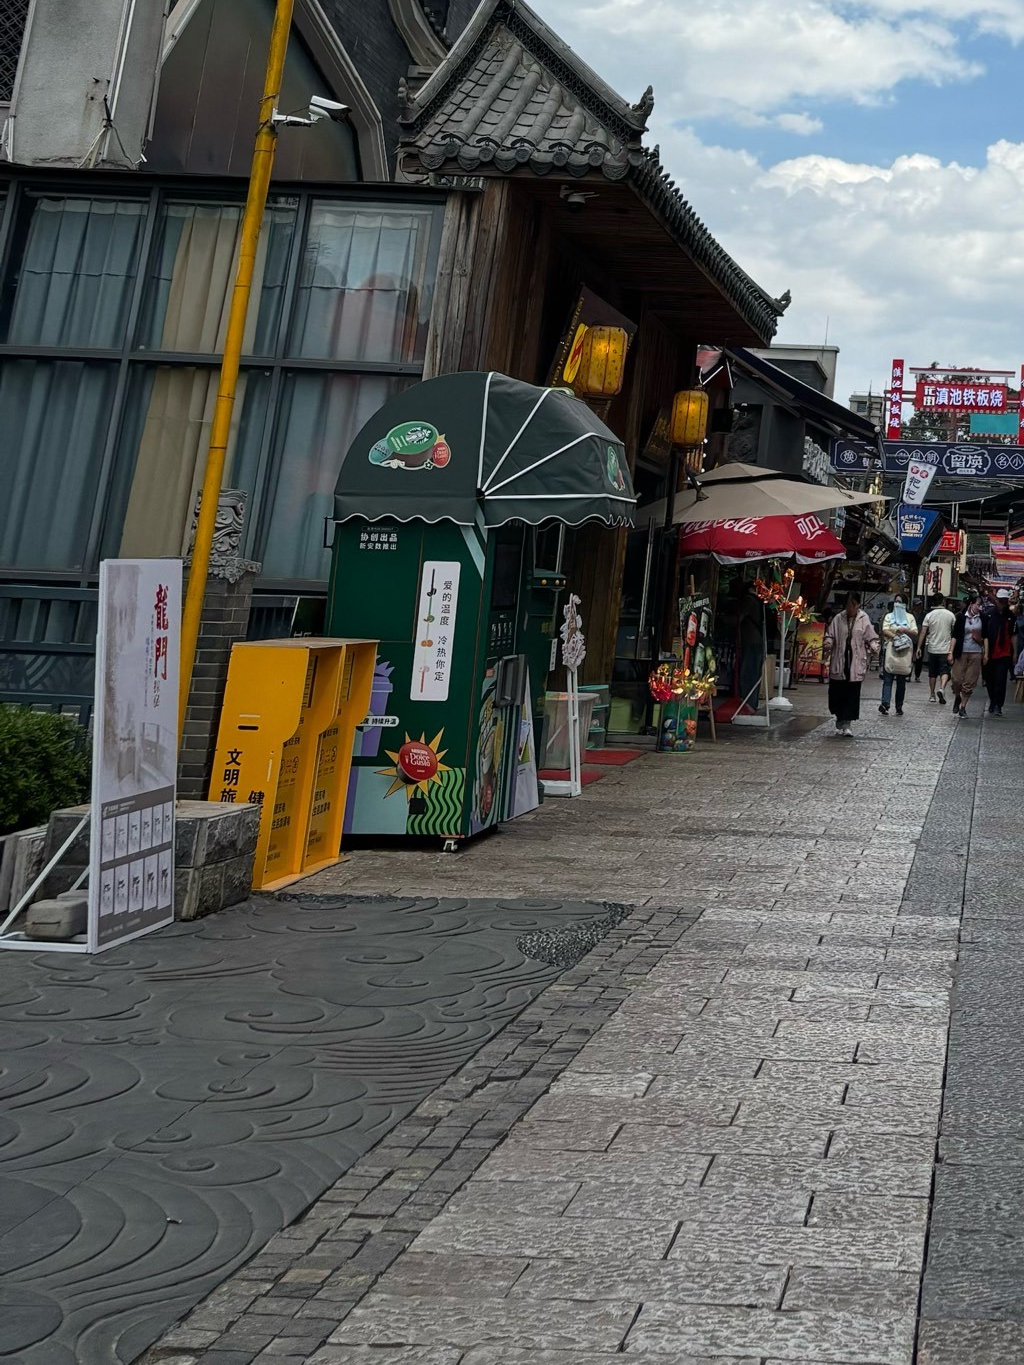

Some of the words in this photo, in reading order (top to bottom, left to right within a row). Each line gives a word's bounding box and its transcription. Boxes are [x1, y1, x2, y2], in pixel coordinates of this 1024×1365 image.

[935, 387, 1003, 407] 滇池铁板烧
[440, 580, 453, 626] 爱的温度
[154, 583, 169, 681] 龍門
[434, 636, 448, 681] 冷热你定
